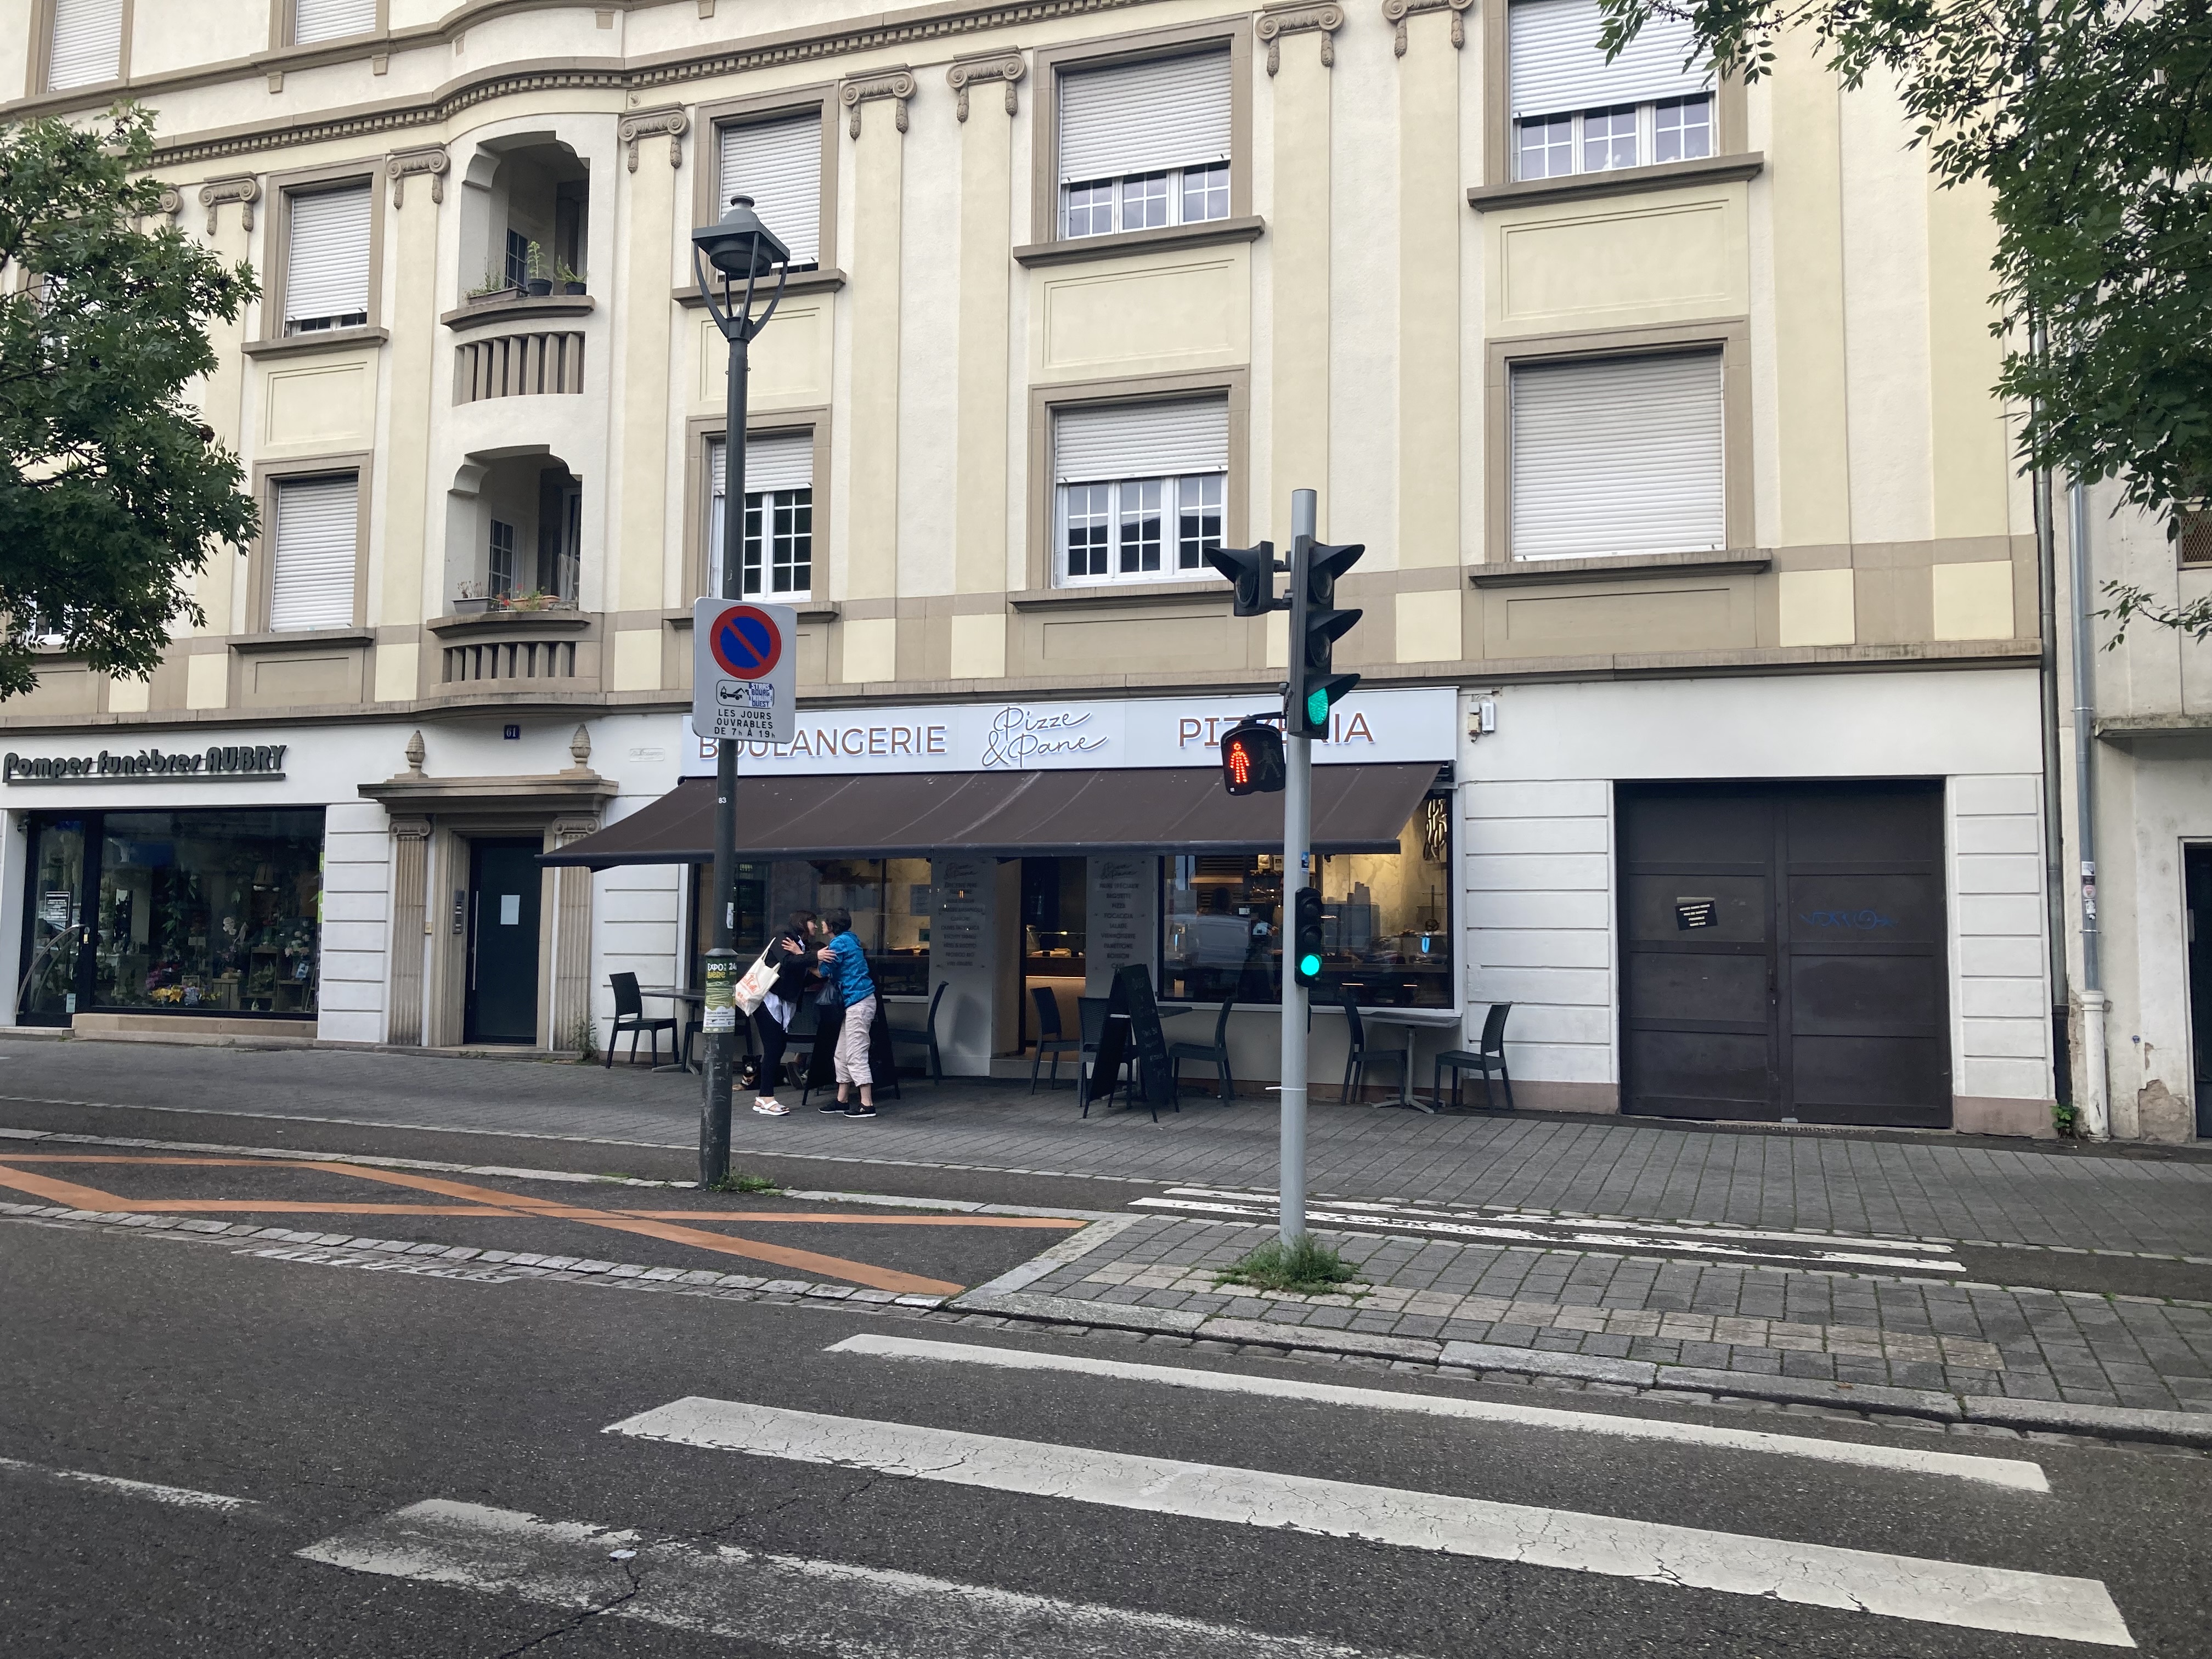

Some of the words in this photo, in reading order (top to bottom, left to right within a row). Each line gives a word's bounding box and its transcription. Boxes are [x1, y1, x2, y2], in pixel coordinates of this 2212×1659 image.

[718, 708, 736, 717] LES
[741, 710, 771, 720] JOURS
[716, 718, 773, 729] OUVRABLES
[993, 706, 1092, 741] Pizze
[506, 727, 516, 737] 61
[714, 726, 726, 735] DE
[747, 727, 753, 737] À
[759, 730, 775, 738] 19h
[699, 726, 946, 759] BULANGERIE
[2, 752, 92, 781] Pompes
[205, 744, 287, 772] AUBRY
